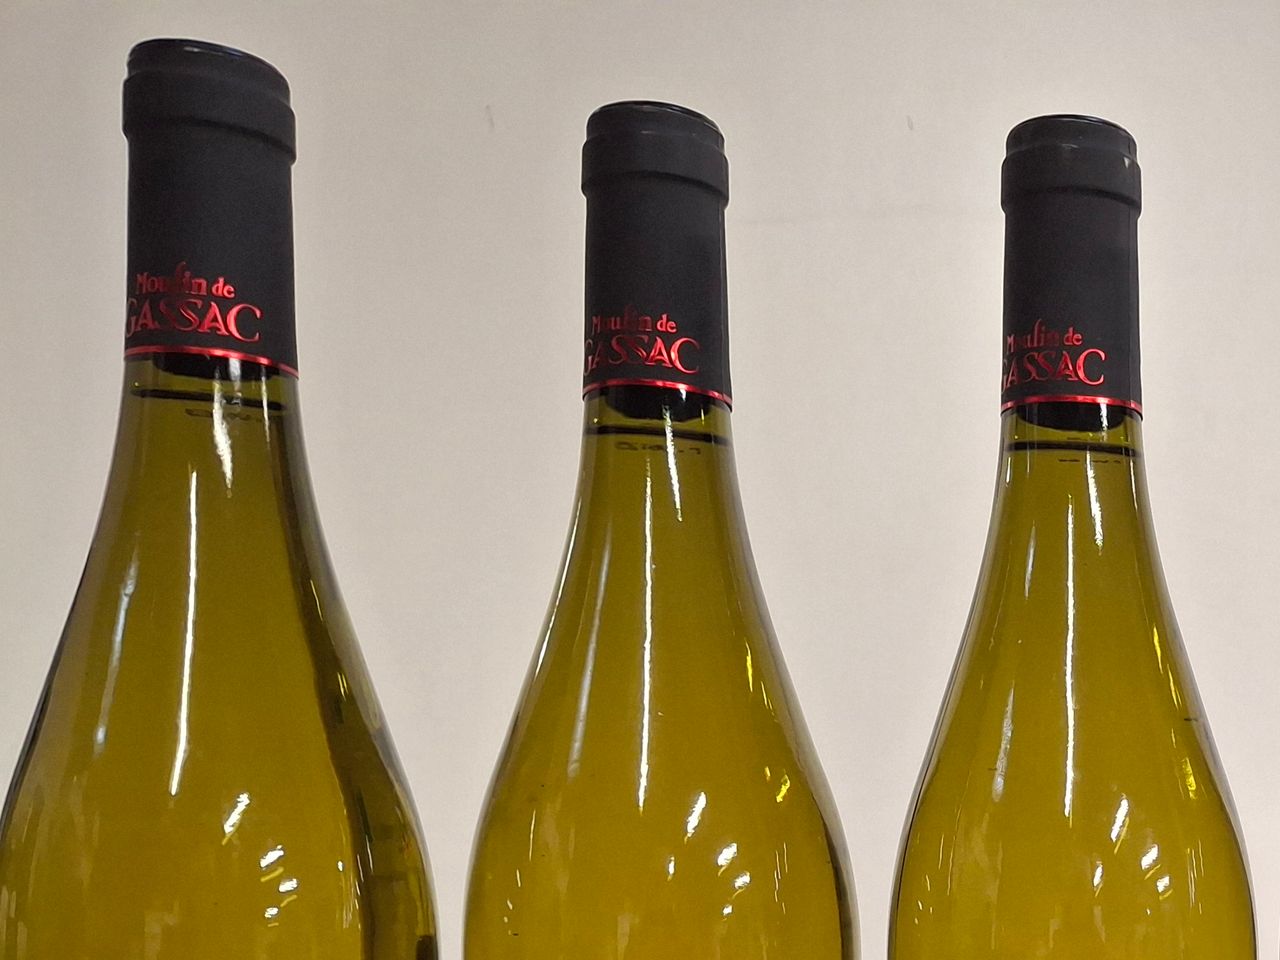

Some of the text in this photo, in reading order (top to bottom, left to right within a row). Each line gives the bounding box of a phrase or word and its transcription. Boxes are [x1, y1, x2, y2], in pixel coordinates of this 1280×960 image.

[212, 277, 235, 298] de
[126, 298, 263, 342] GASSAC
[656, 314, 677, 333] de
[1064, 327, 1083, 345] de
